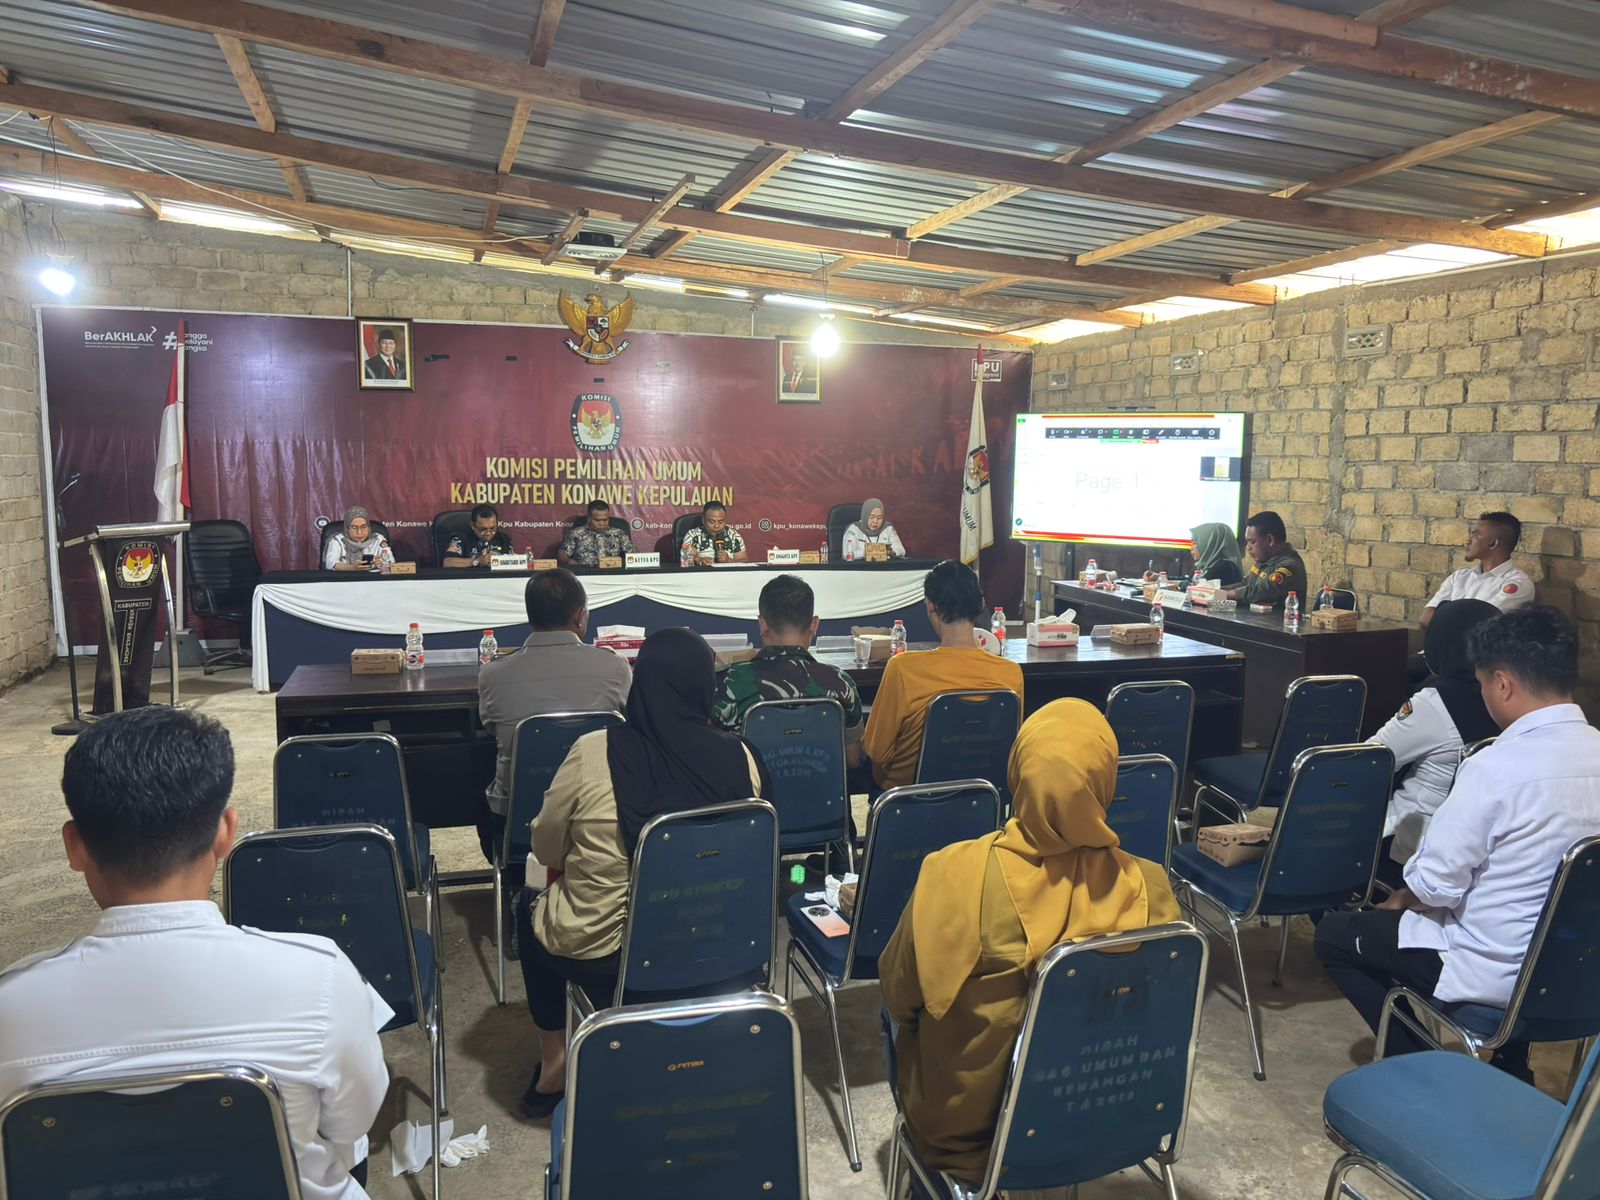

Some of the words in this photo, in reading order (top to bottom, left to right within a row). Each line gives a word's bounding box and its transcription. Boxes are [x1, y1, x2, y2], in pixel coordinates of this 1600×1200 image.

[84, 331, 154, 342] BerAKHLAK
[581, 394, 611, 402] KOMISI
[572, 426, 606, 451] PEMILIHAN
[607, 426, 620, 450] UMUM
[486, 456, 548, 479] KOMISI
[553, 458, 647, 480] PEMILIHAN
[653, 461, 702, 481] UMUM
[1075, 471, 1124, 493] Page
[450, 482, 556, 505] KABUPATEN
[561, 483, 633, 506] KONAWE
[637, 485, 733, 506] KEPULAUAN
[497, 520, 513, 528] Kpu
[514, 520, 554, 528] Kabupaten
[645, 521, 673, 529] kab-kon
[117, 600, 150, 609] KABUPATEN
[1082, 1054, 1134, 1074] UMUM
